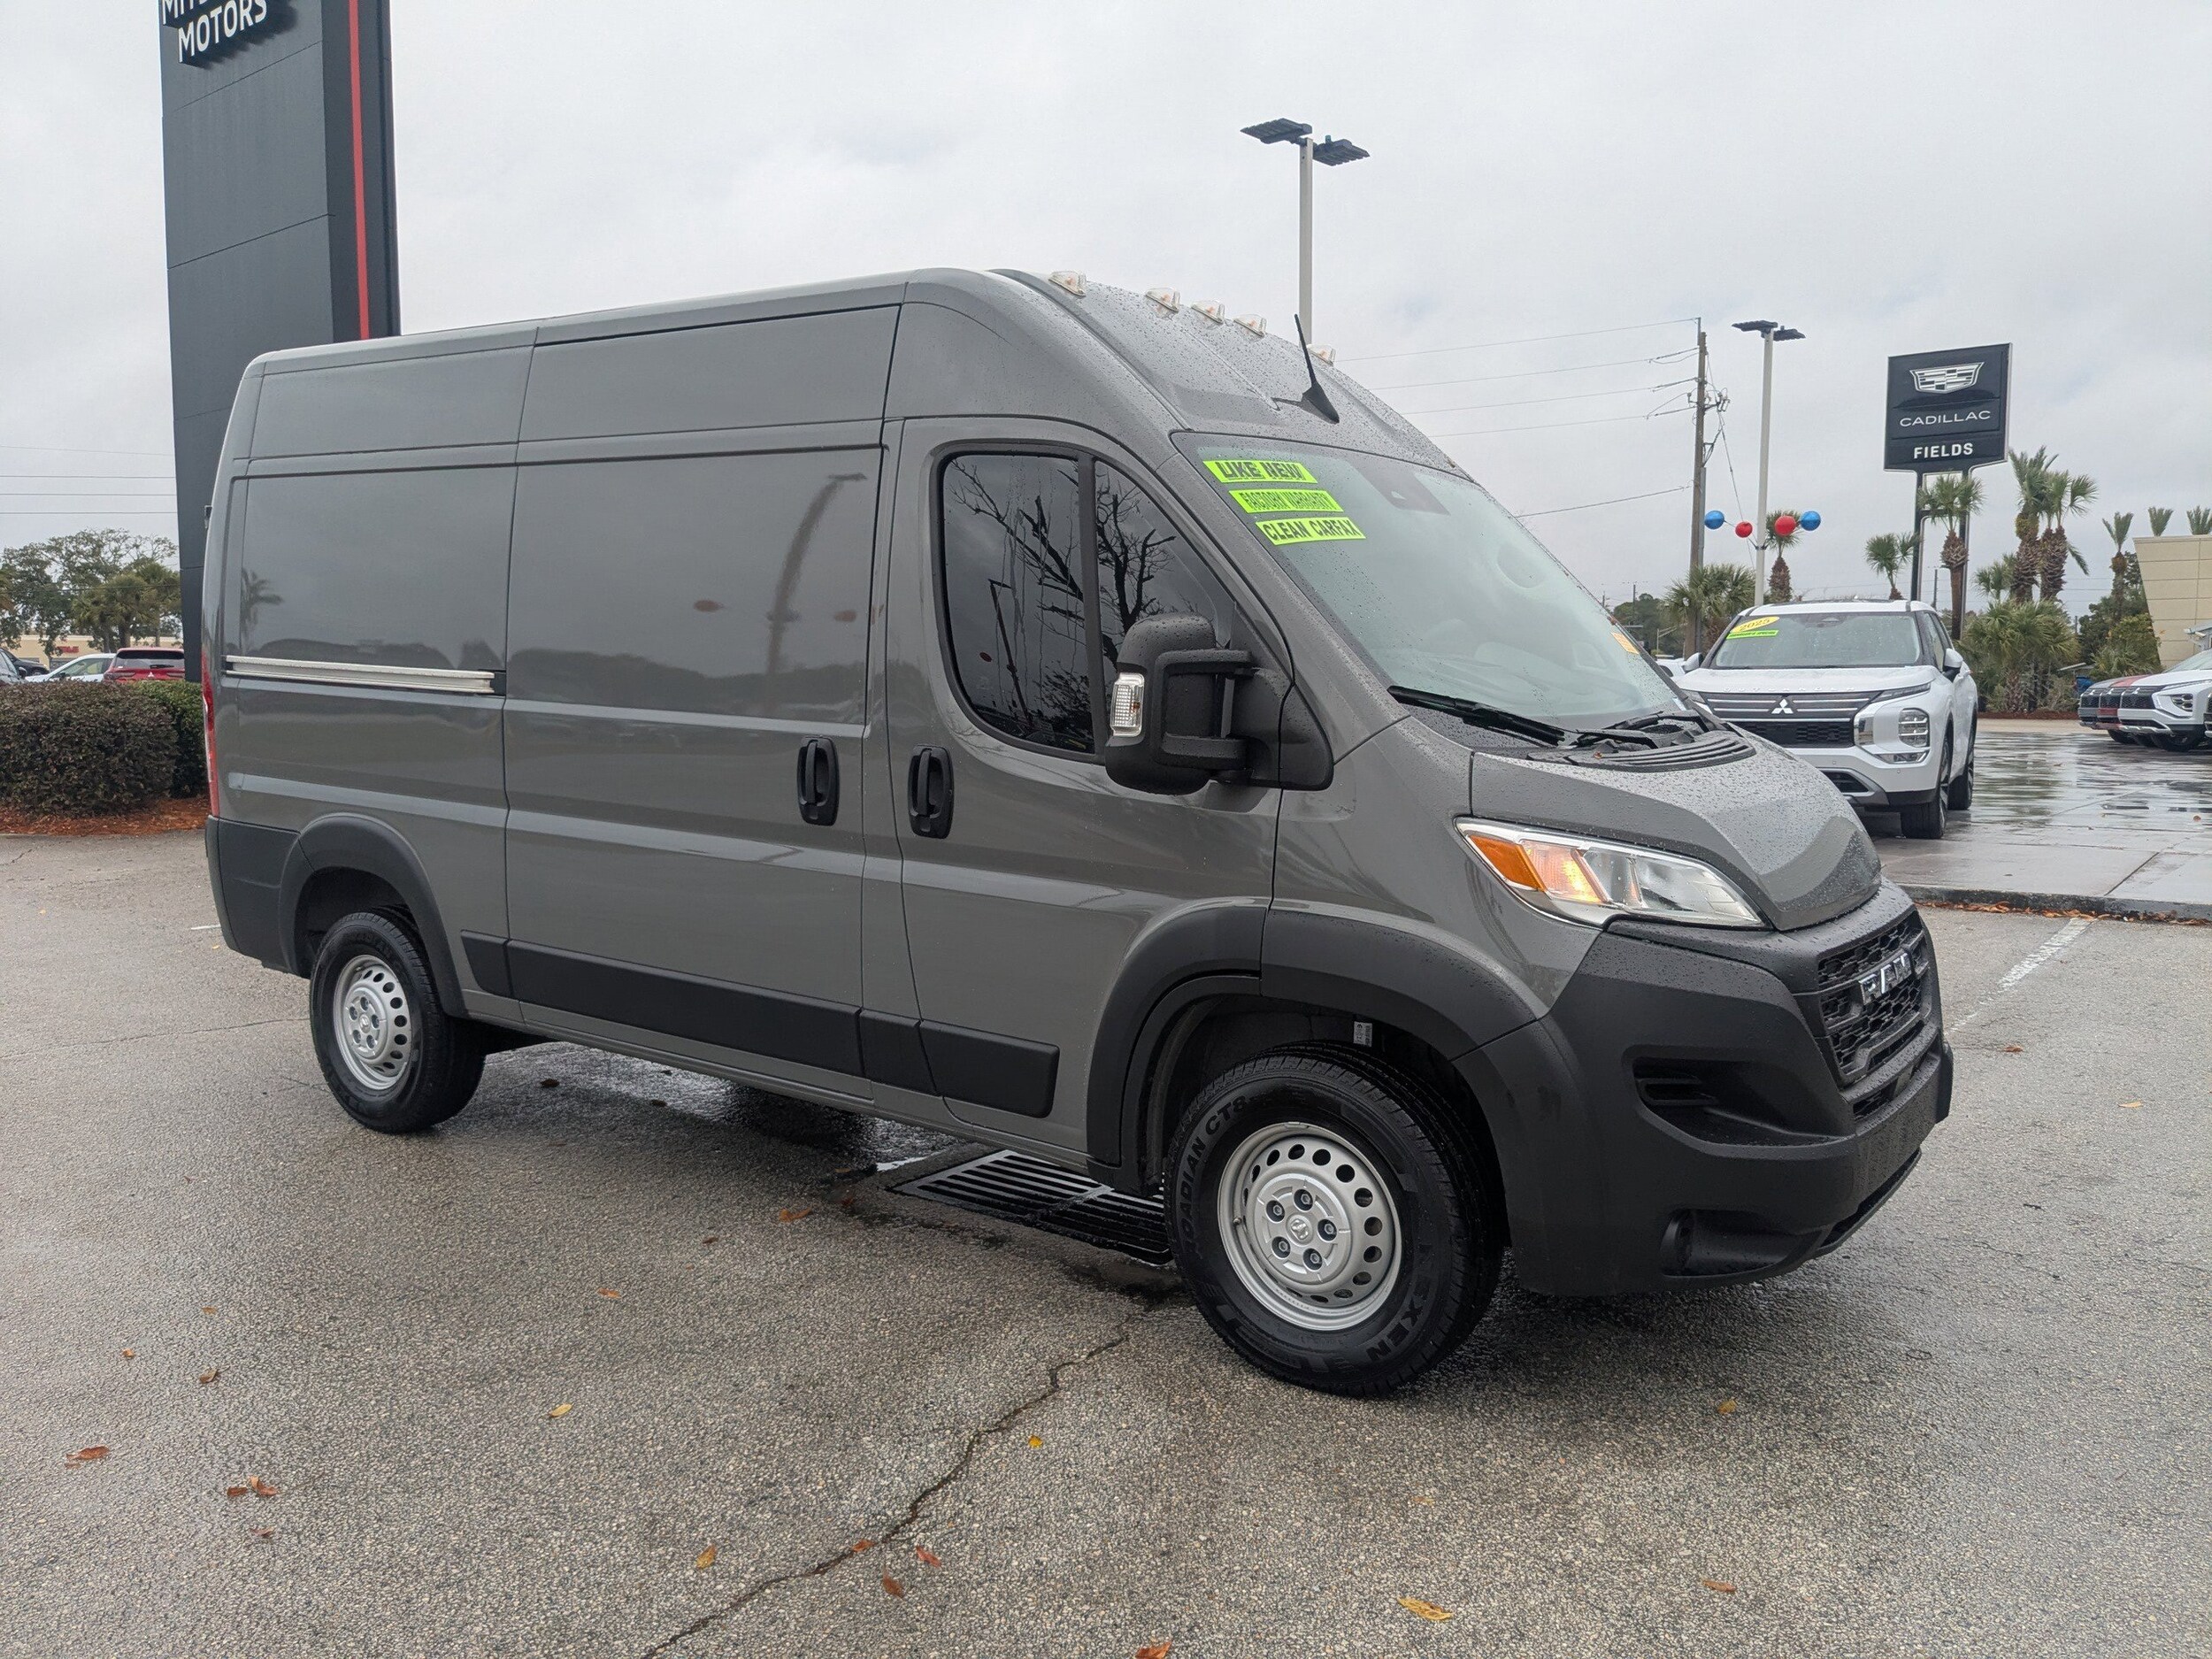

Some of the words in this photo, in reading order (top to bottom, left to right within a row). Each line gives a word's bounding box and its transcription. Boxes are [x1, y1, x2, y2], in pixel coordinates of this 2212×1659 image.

[178, 0, 267, 63] MOTORS
[1900, 410, 1991, 427] CADILLAC
[1913, 442, 1974, 459] FIELDS
[1215, 461, 1265, 480] LIKE
[1261, 462, 1306, 480] NEW
[1262, 520, 1313, 541] CLEAN
[1309, 518, 1363, 538] CARFAX
[1858, 952, 1912, 1006] RAM
